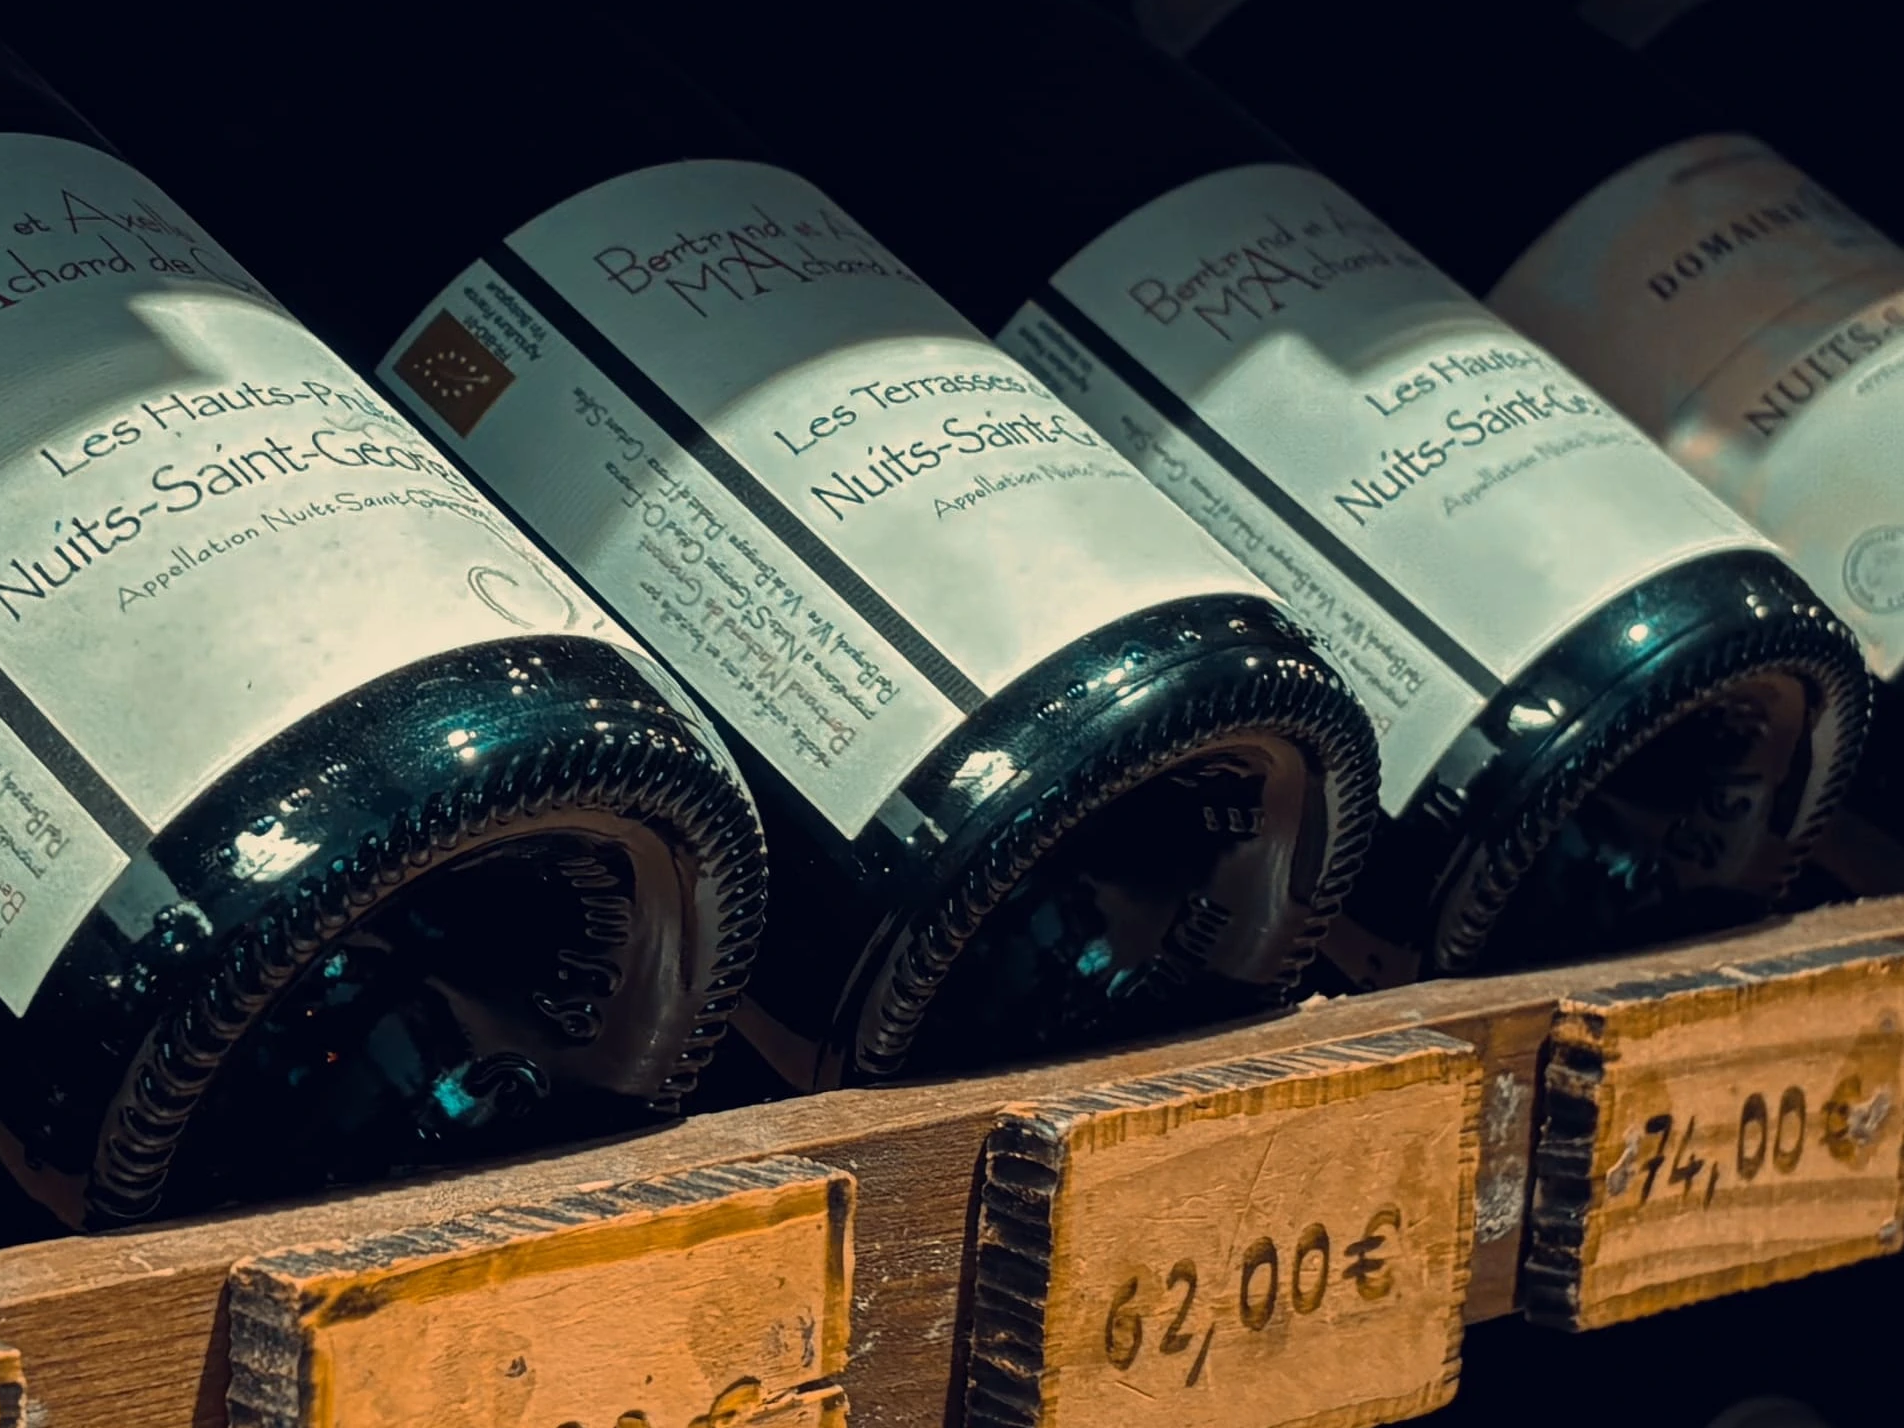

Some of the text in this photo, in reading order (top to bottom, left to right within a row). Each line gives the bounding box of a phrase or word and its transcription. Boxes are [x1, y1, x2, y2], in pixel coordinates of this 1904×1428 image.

[13, 213, 49, 237] et
[774, 405, 857, 457] Les
[849, 374, 1027, 410] Terrasses
[1364, 371, 1435, 417] Les
[41, 420, 142, 478] Les
[118, 529, 259, 614] Appellation
